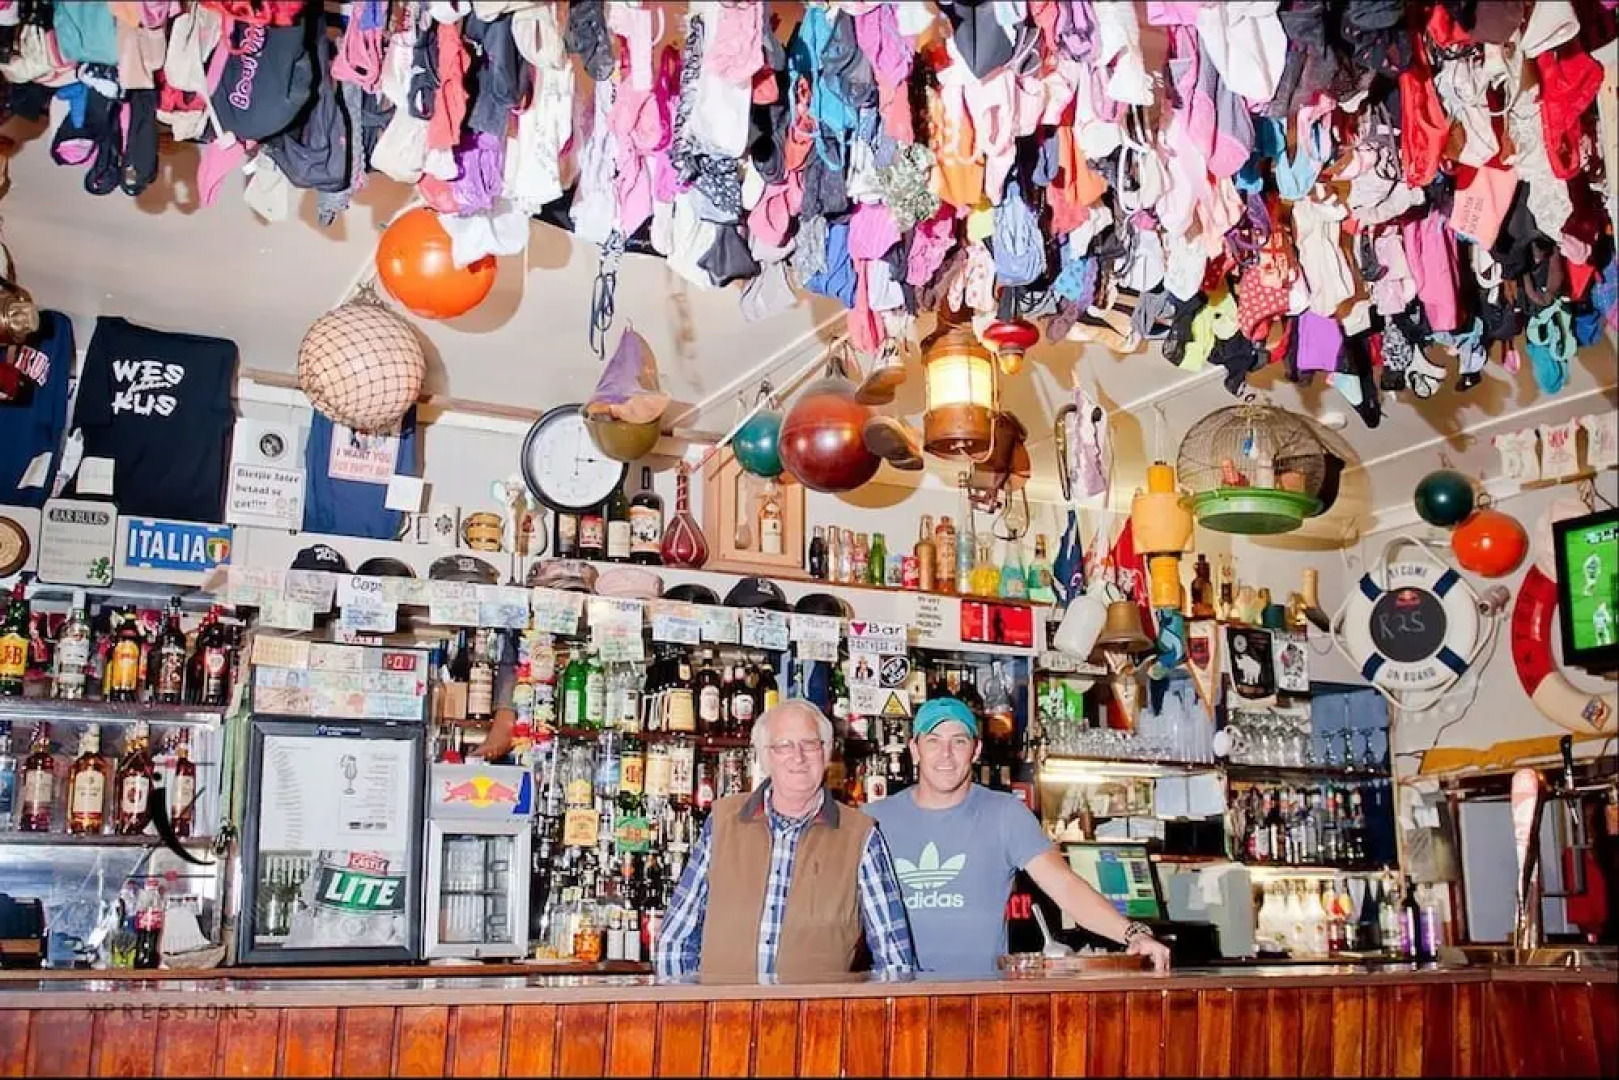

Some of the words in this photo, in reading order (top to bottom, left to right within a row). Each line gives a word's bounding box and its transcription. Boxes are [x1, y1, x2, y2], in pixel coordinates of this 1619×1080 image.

[112, 359, 185, 386] WES
[111, 391, 178, 416] KUS
[51, 510, 76, 522] BAR
[78, 511, 108, 524] RULES
[129, 527, 206, 564] ITALIA
[868, 622, 902, 635] Bar
[325, 873, 400, 906] LITE
[903, 890, 964, 909] didas
